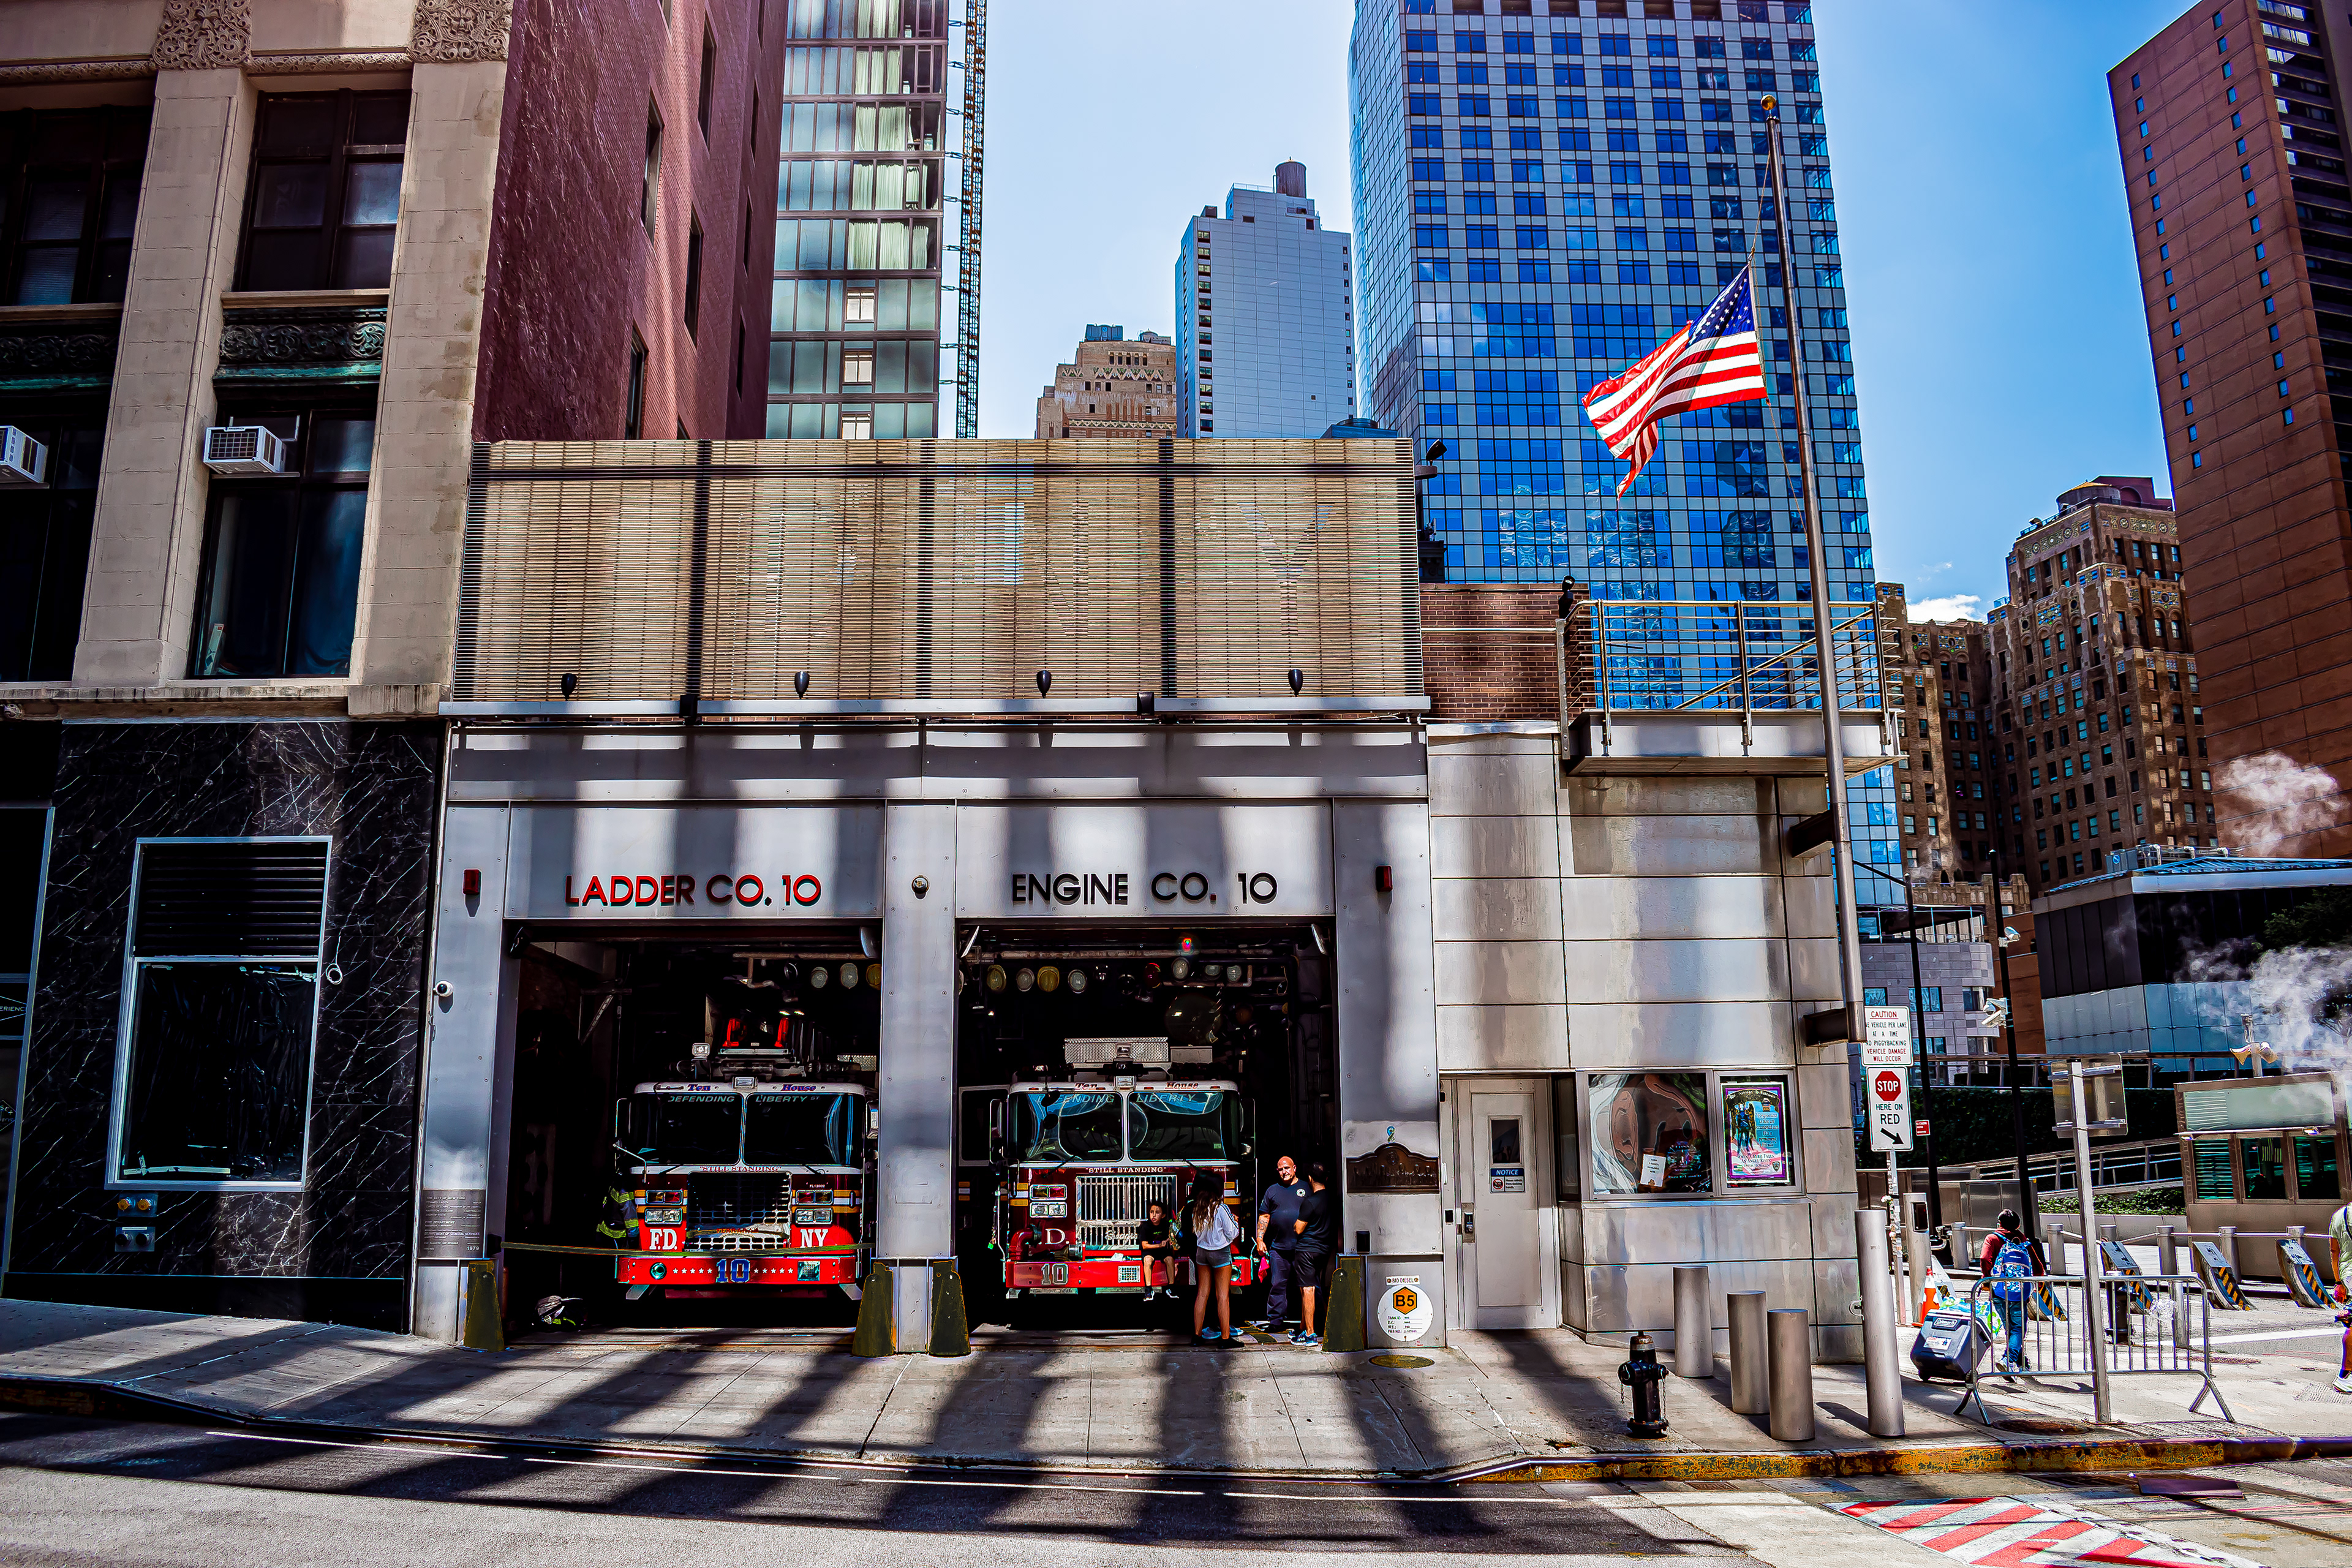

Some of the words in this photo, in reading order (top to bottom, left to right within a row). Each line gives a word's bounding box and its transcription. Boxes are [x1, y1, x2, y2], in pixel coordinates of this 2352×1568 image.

[565, 875, 696, 906] LADDER
[706, 873, 773, 906] CO.
[782, 873, 822, 906] 10
[1012, 872, 1128, 905] ENGINE
[1152, 872, 1217, 903] CO.
[1237, 872, 1278, 904] 10
[1877, 1080, 1899, 1092] STOP
[1038, 1095, 1115, 1103] DFENDING
[1136, 1094, 1196, 1102] LIBERTY
[1880, 1114, 1900, 1125] RED
[650, 1229, 678, 1250] F.D.
[716, 1259, 750, 1283] 10
[1041, 1263, 1068, 1285] 10
[1396, 1295, 1414, 1307] B5
